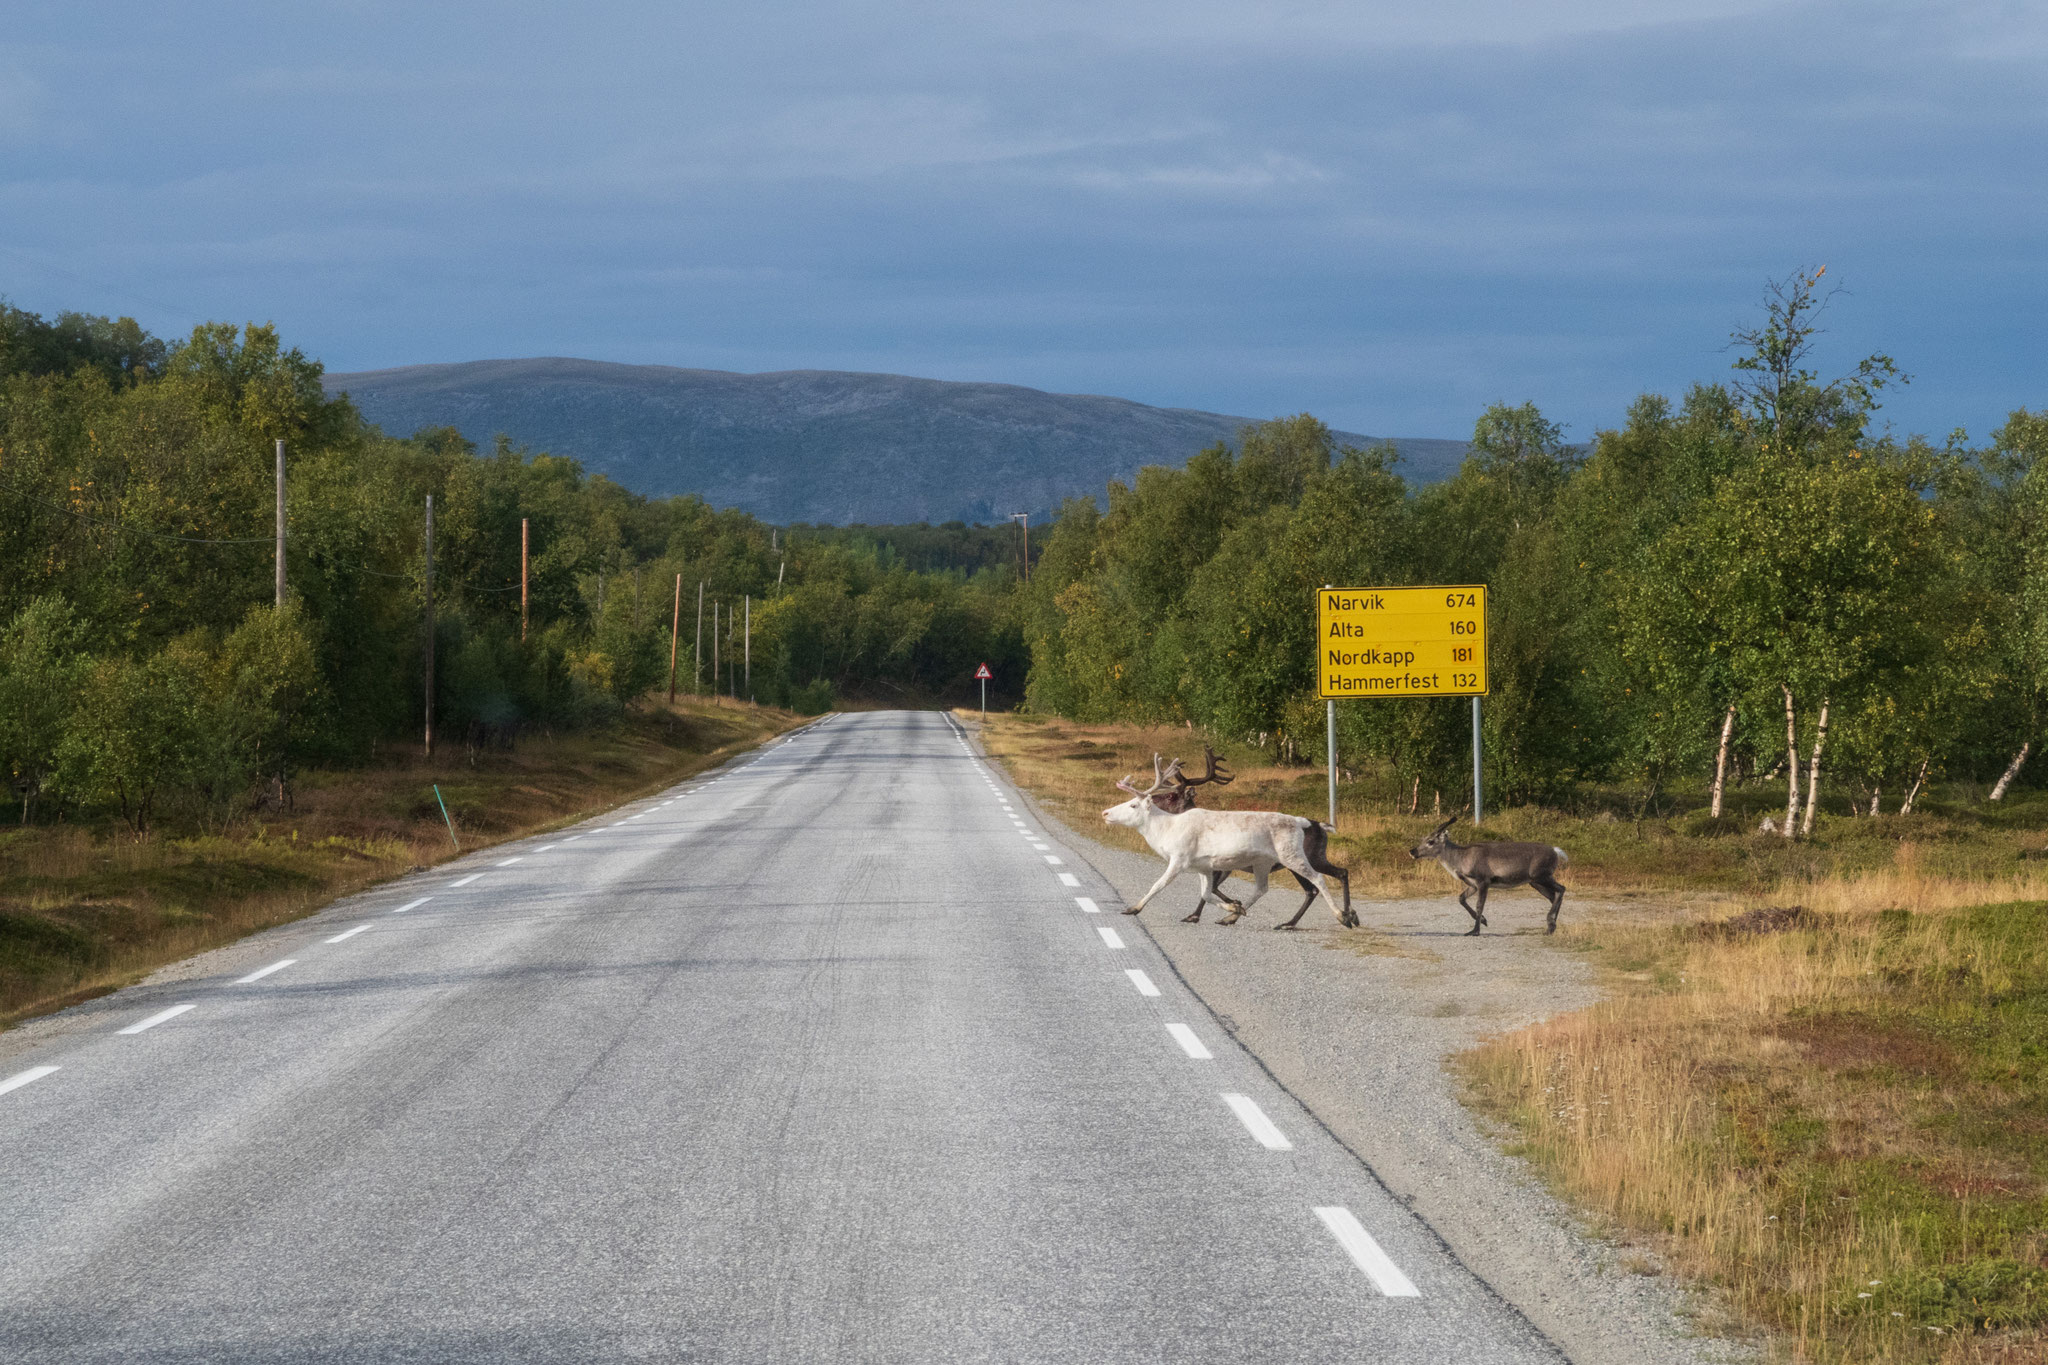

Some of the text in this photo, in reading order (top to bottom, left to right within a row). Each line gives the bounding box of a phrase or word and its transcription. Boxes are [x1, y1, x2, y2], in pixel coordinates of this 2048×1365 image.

[1328, 594, 1476, 611] Narvik 674
[1329, 621, 1476, 638] Alta 160
[1329, 648, 1472, 667] Nordkapp 181
[1329, 673, 1477, 690] Hammerfest 132
